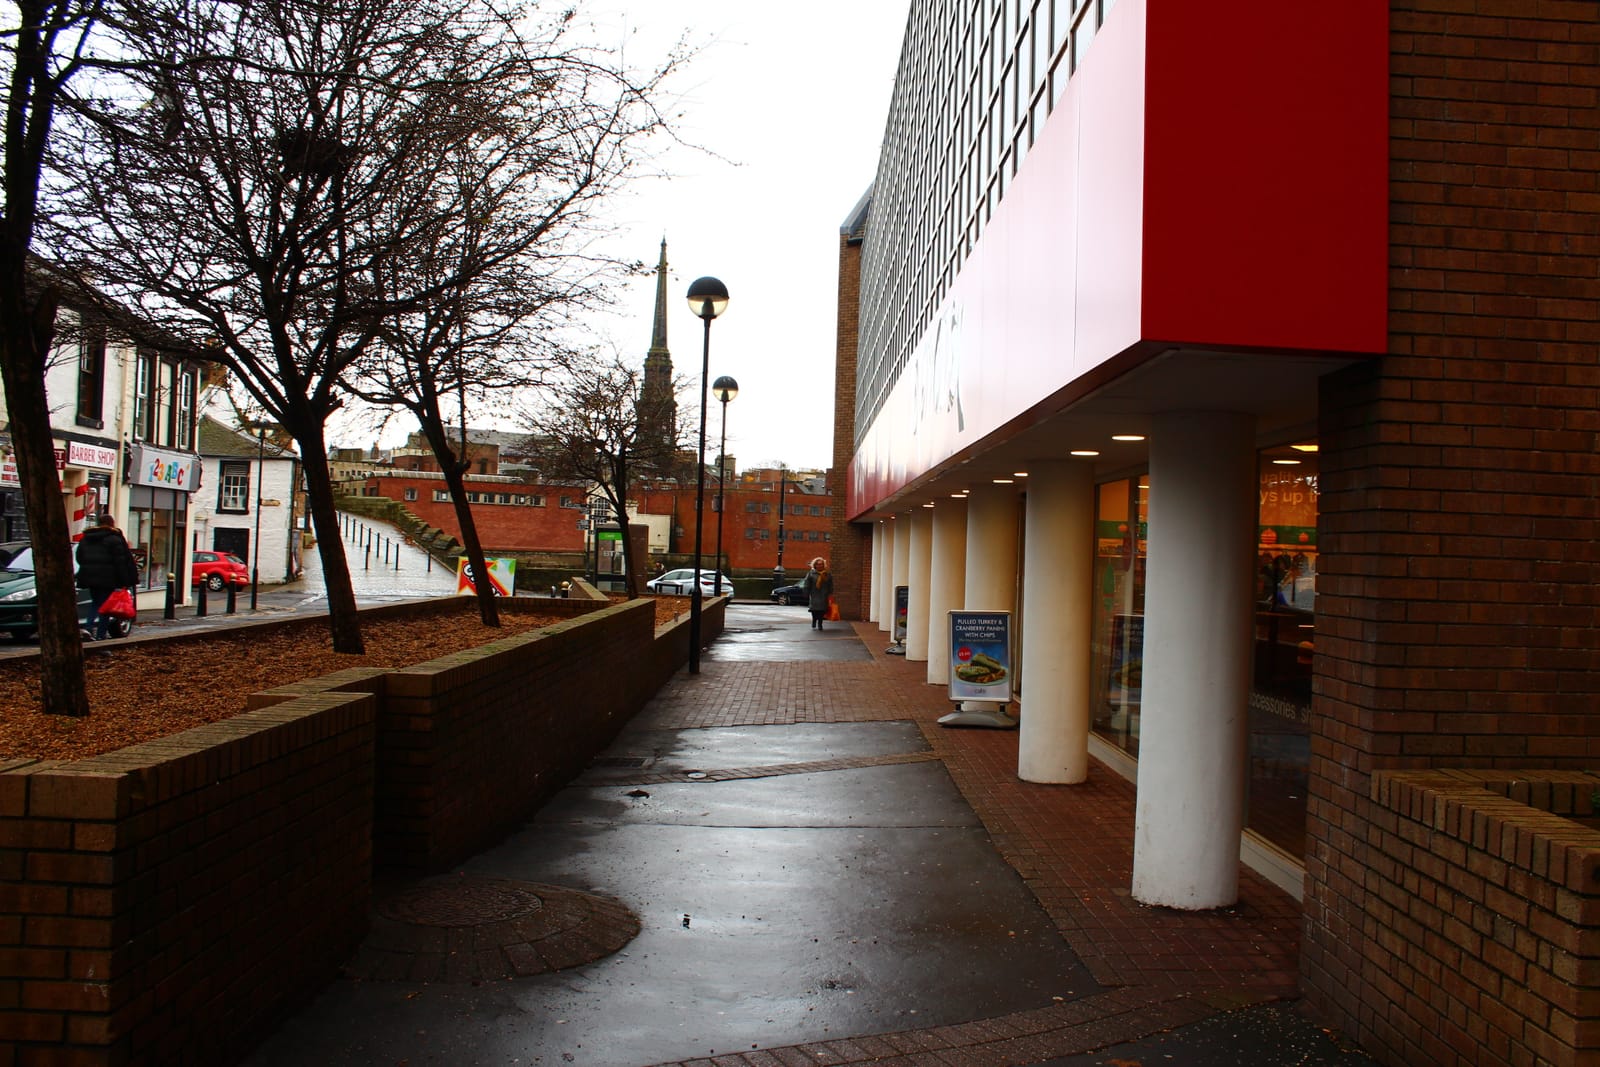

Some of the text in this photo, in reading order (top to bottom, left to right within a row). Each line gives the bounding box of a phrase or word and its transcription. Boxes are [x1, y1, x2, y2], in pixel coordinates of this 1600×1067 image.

[70, 445, 96, 463] BARBER
[97, 450, 115, 466] SHOP
[164, 461, 185, 486] ABC
[1283, 491, 1303, 505] up
[1250, 692, 1296, 720] ccessories
